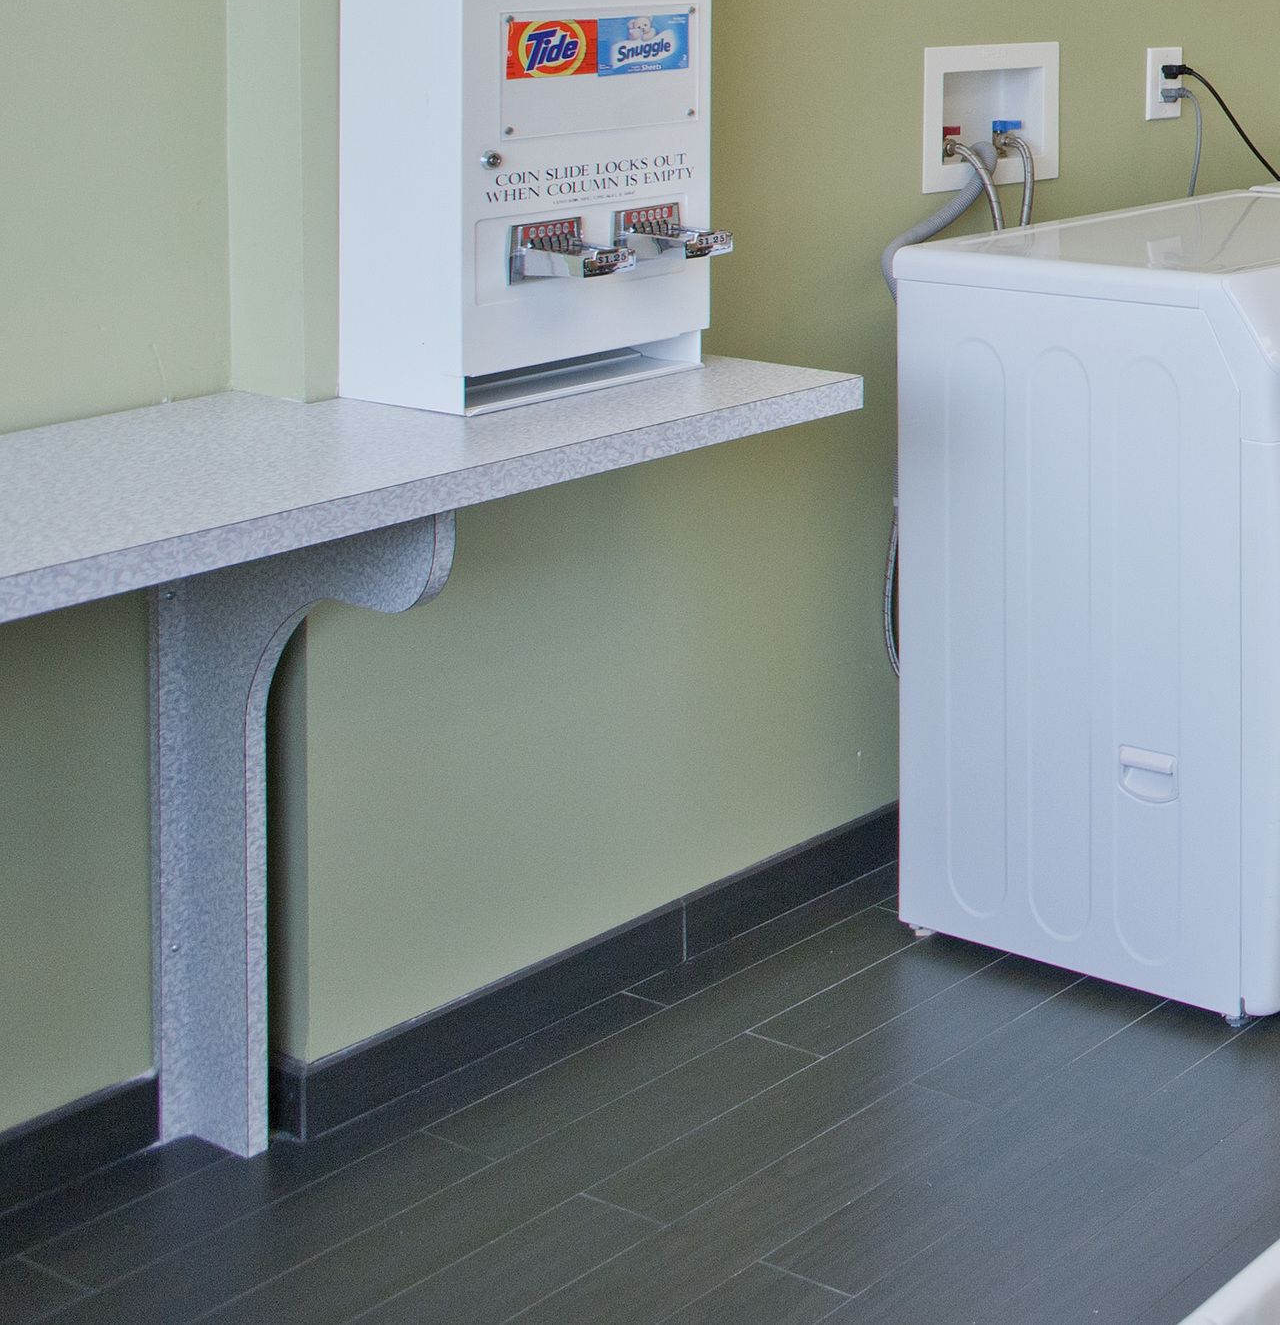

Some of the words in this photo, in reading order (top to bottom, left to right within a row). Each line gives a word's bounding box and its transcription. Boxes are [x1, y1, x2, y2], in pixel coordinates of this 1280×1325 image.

[525, 27, 580, 73] Tide
[617, 38, 671, 63] Snuggle
[641, 63, 662, 71] Sheets
[495, 170, 541, 186] COIN
[545, 164, 590, 181] SLIDE
[596, 158, 648, 175] LOCKS
[653, 152, 687, 168] OUT
[486, 186, 541, 203] WHEN
[547, 175, 620, 197] COLUMN
[625, 173, 639, 187] IS
[644, 167, 695, 184] EMPTY
[698, 234, 725, 246] $1.25
[598, 253, 627, 264] $1.25
